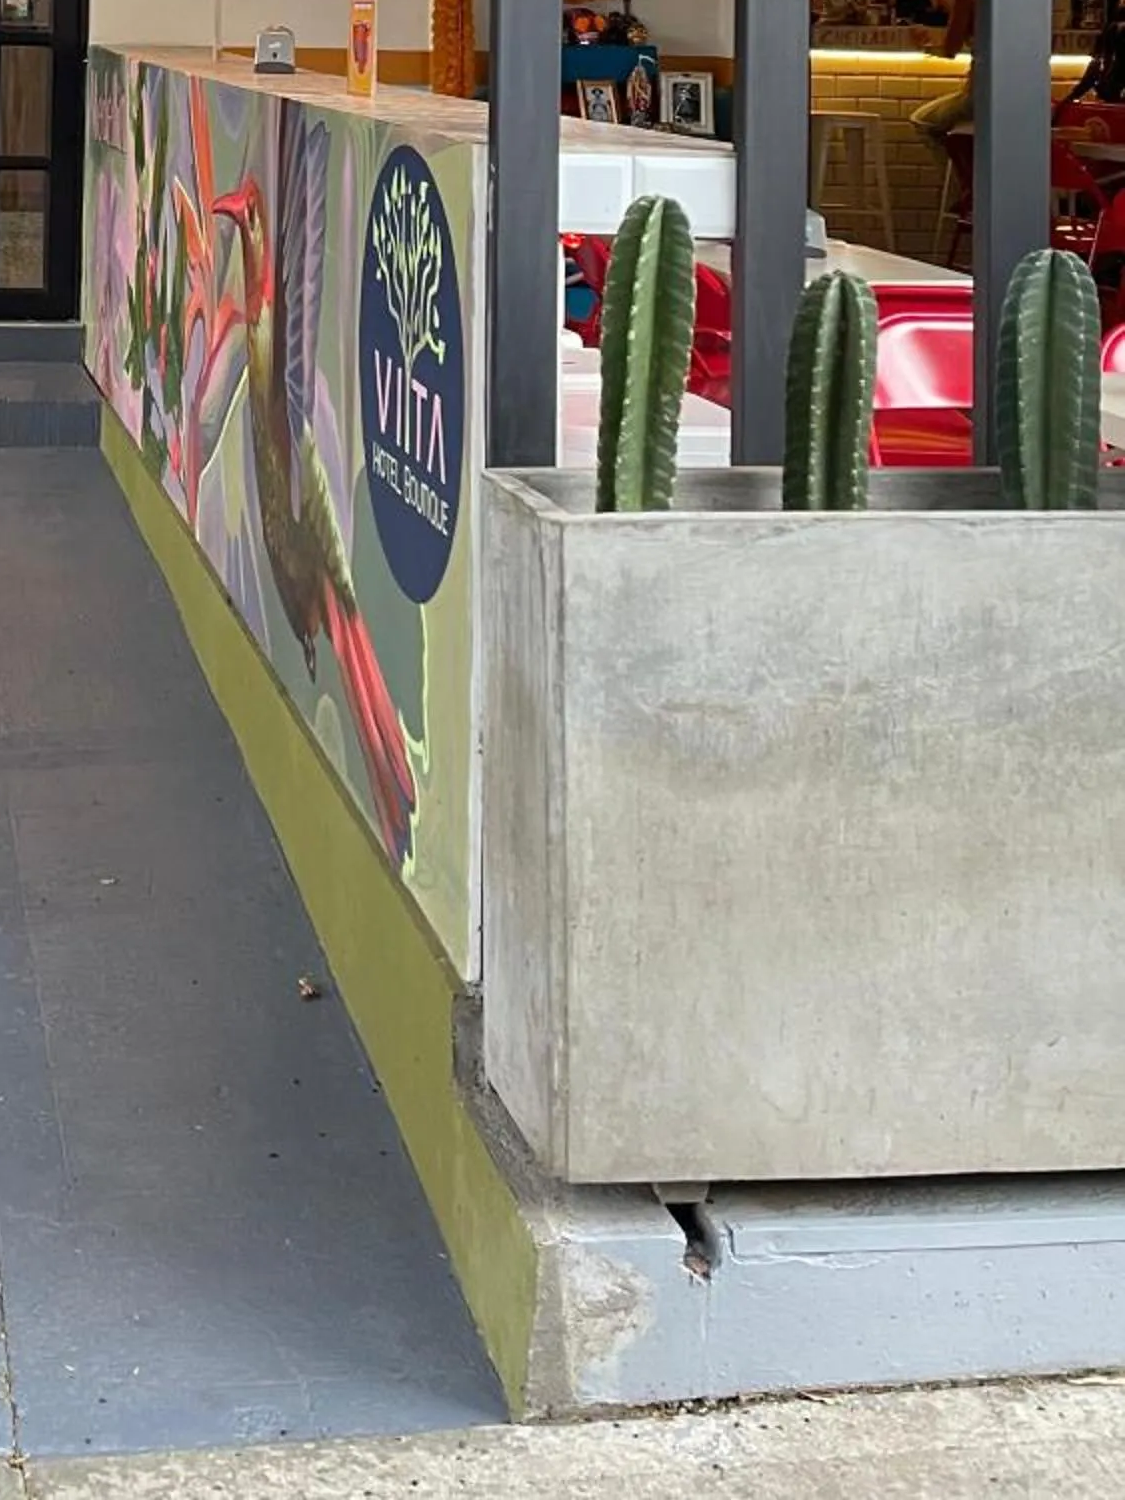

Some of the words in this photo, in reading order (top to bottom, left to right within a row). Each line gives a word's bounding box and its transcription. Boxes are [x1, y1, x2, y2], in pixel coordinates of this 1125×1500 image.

[373, 348, 447, 486] VITA
[372, 440, 403, 496] HOTEL
[403, 464, 450, 537] BOUTIQUE
